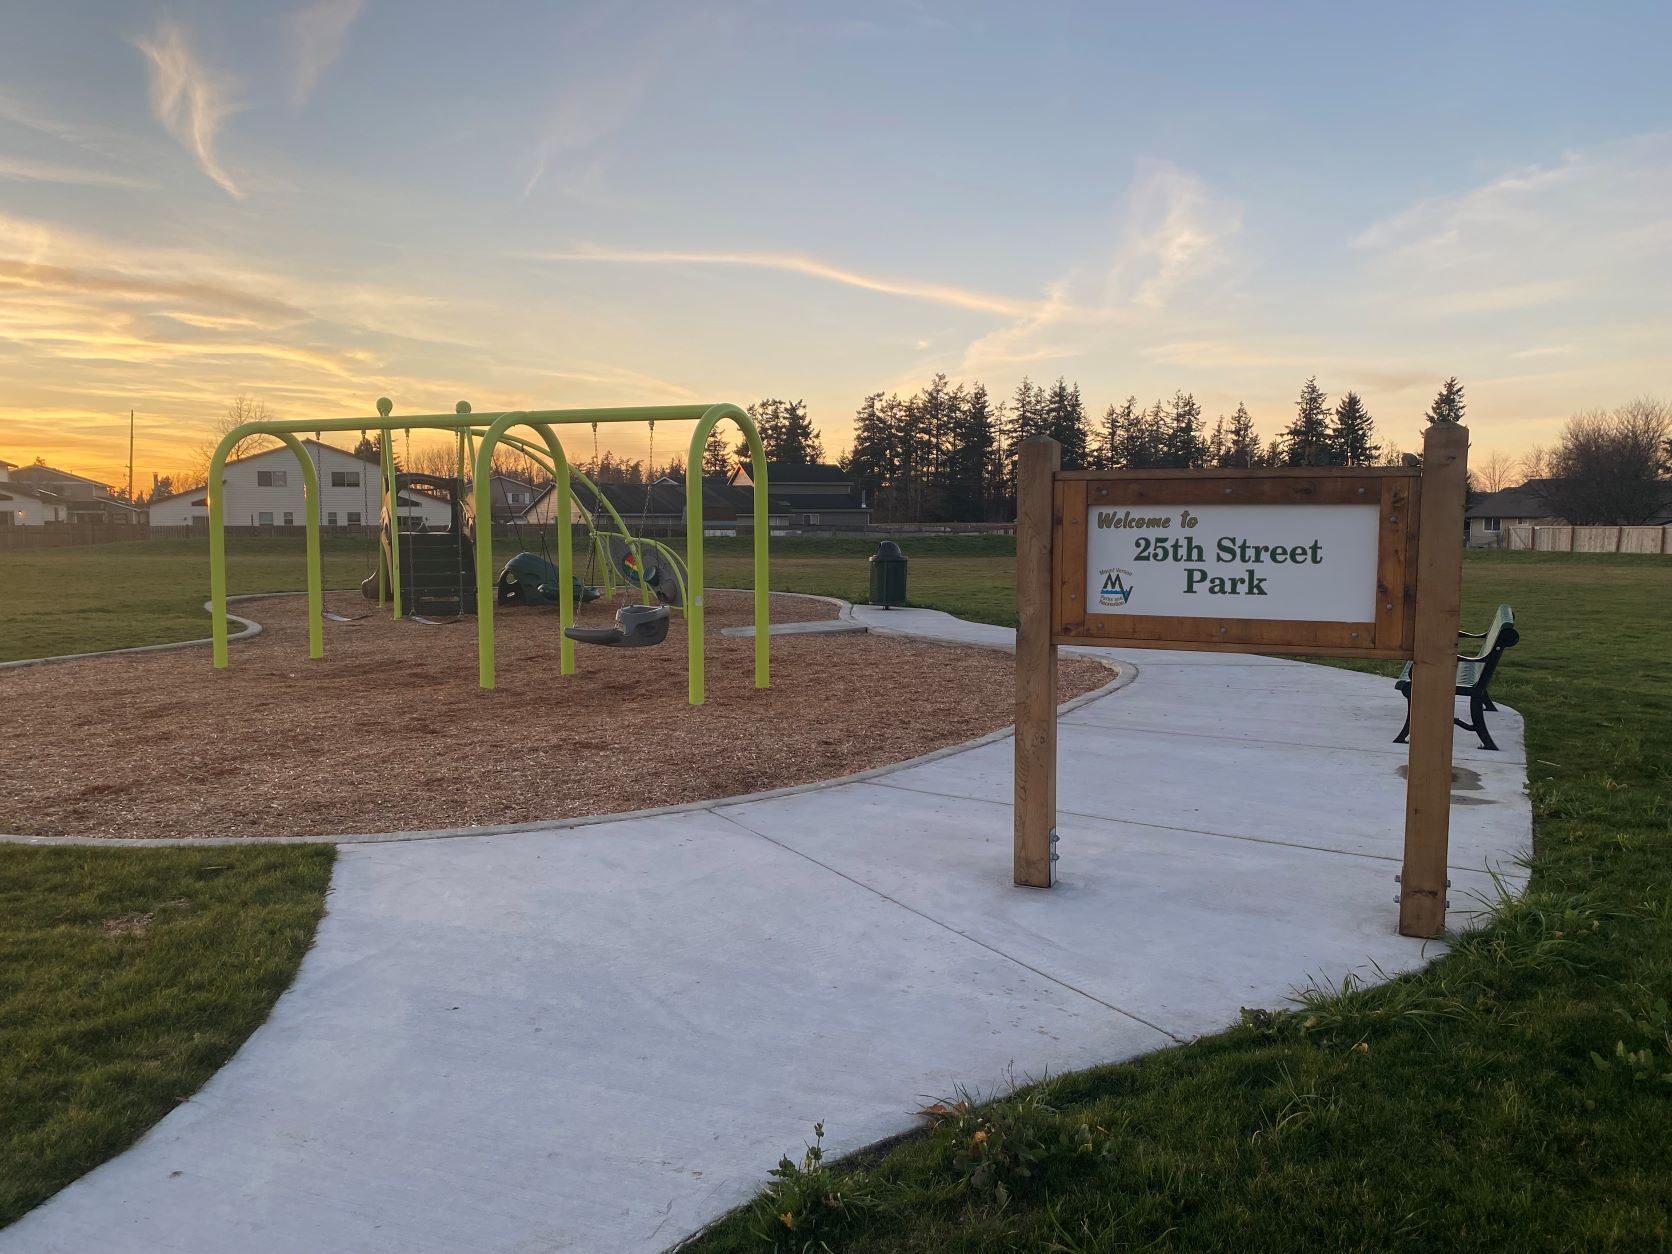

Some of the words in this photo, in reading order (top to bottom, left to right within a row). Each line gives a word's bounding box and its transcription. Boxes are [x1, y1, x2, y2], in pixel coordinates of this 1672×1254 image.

[1097, 511, 1171, 529] Welcome
[1180, 510, 1198, 529] to
[1134, 536, 1206, 563] 25th
[1216, 536, 1323, 564] Street
[1183, 568, 1268, 596] Park
